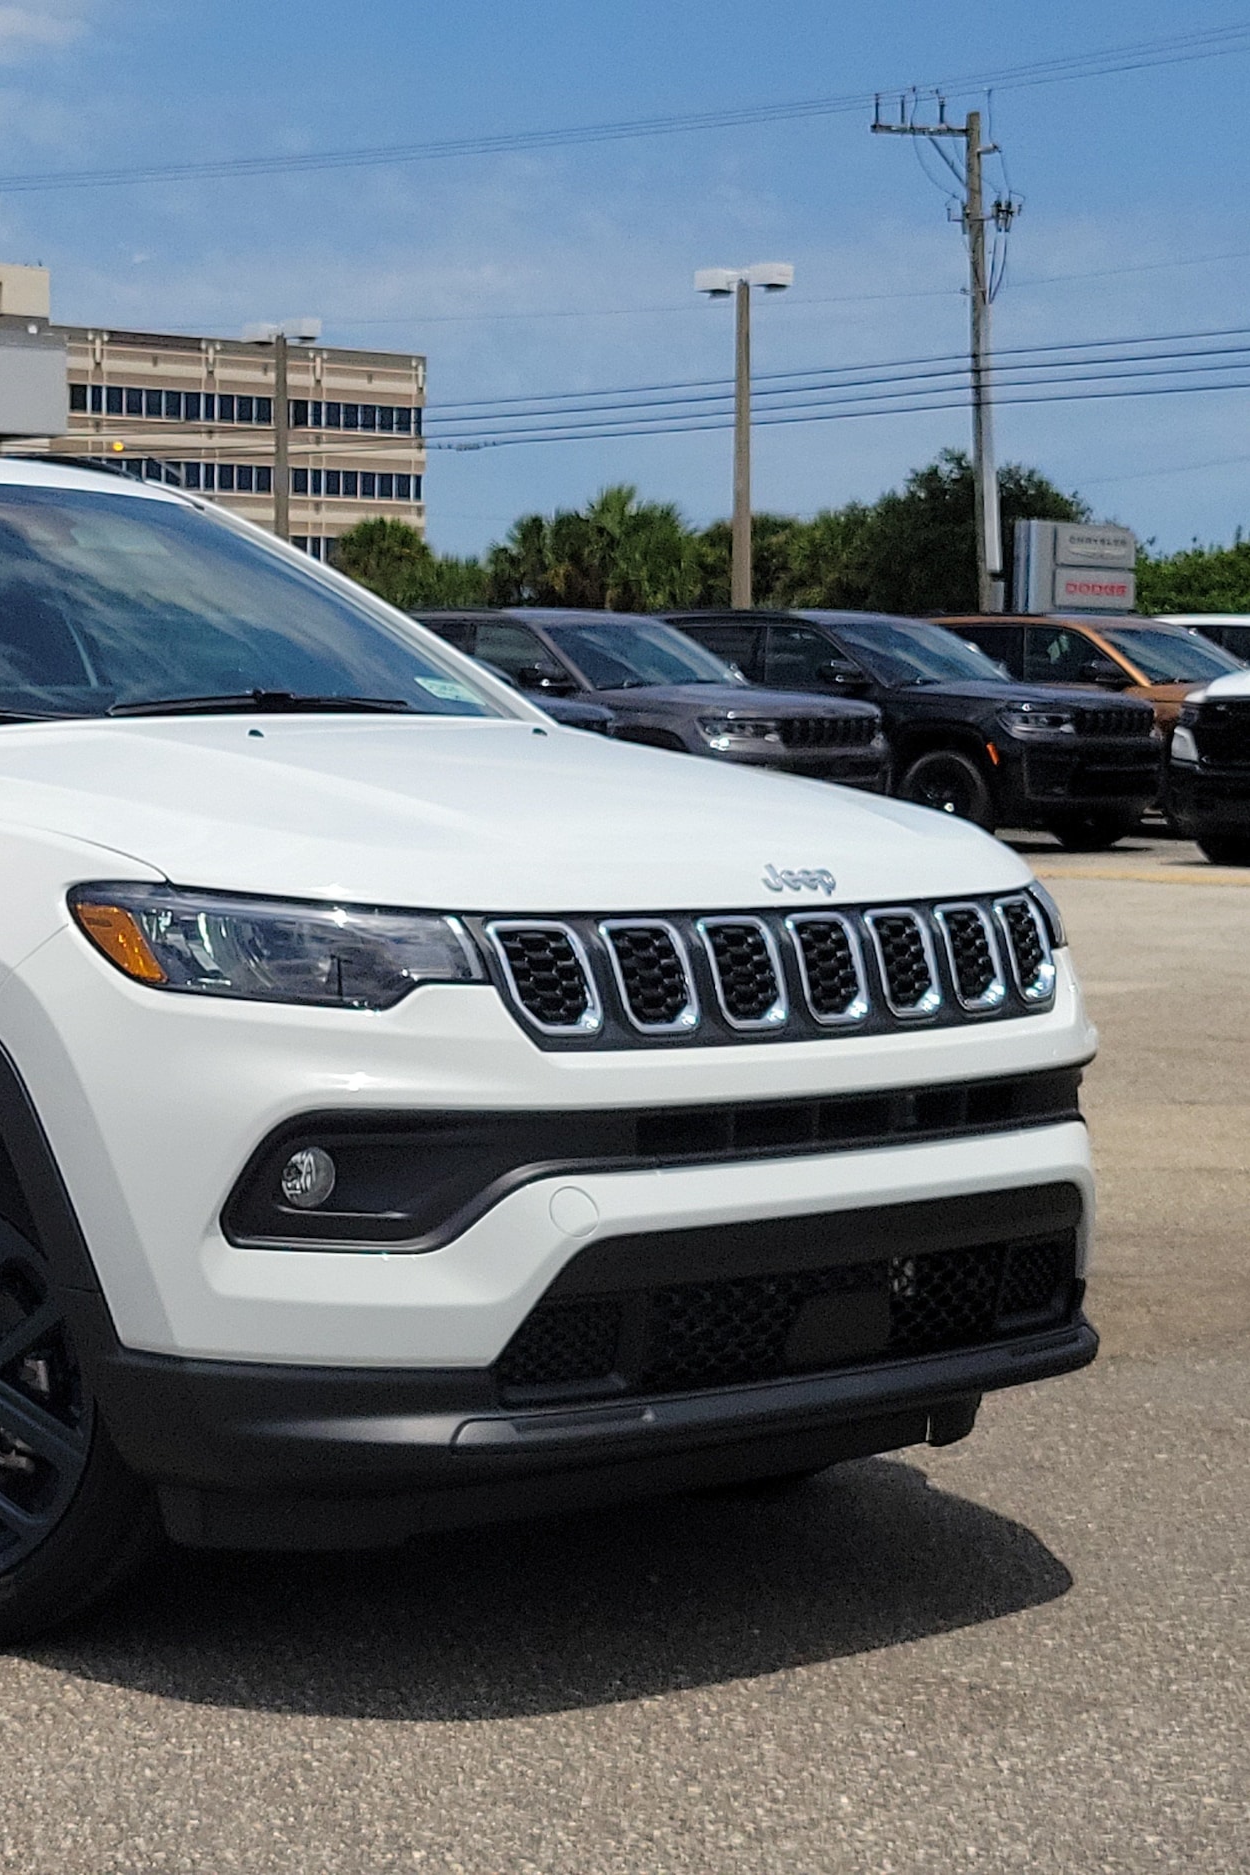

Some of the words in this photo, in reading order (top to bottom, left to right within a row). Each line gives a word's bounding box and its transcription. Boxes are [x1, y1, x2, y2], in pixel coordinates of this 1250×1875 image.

[1068, 535, 1128, 547] CHRYSLER
[1065, 582, 1128, 597] DODGE
[761, 863, 837, 897] Jeep
